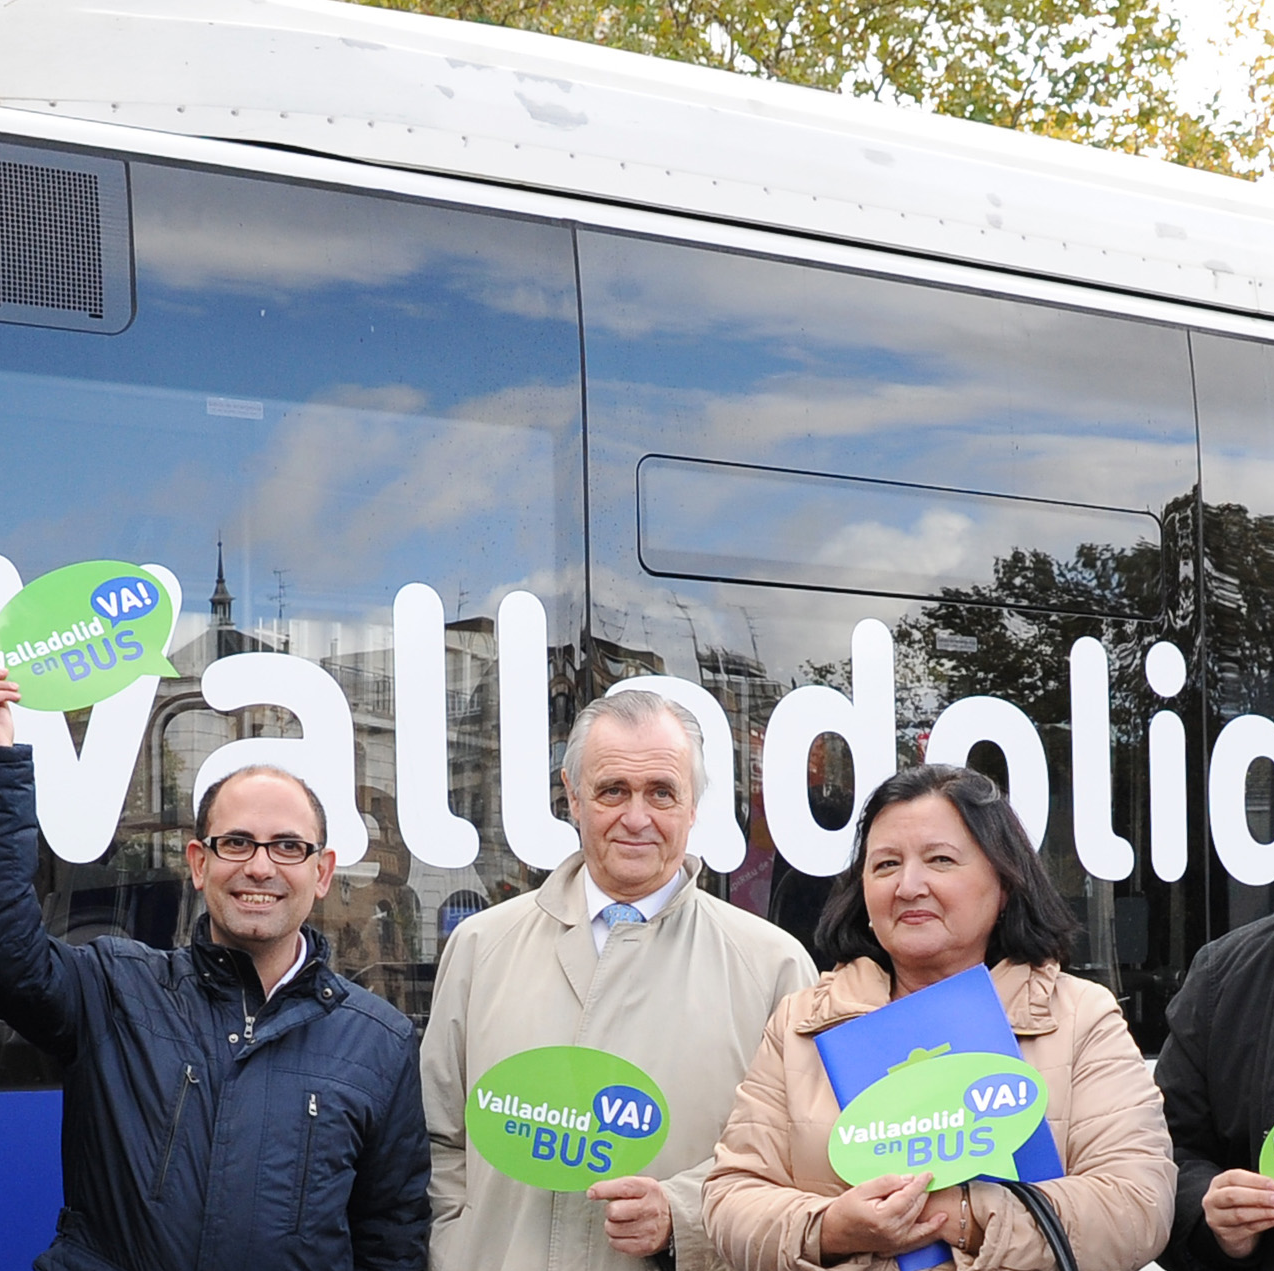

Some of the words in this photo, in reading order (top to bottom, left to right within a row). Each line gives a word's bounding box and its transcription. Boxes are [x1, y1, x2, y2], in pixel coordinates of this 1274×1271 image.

[96, 582, 152, 617] VA!
[31, 656, 59, 676] en
[60, 630, 144, 682] BUS
[477, 1088, 591, 1132] Valladolid
[601, 1095, 653, 1131] VA!
[838, 1108, 965, 1145] Valladolid
[970, 1081, 1027, 1112] VA!
[505, 1120, 531, 1138] en
[531, 1127, 613, 1173] BUS
[873, 1140, 902, 1155] en
[907, 1126, 995, 1167] BUS
